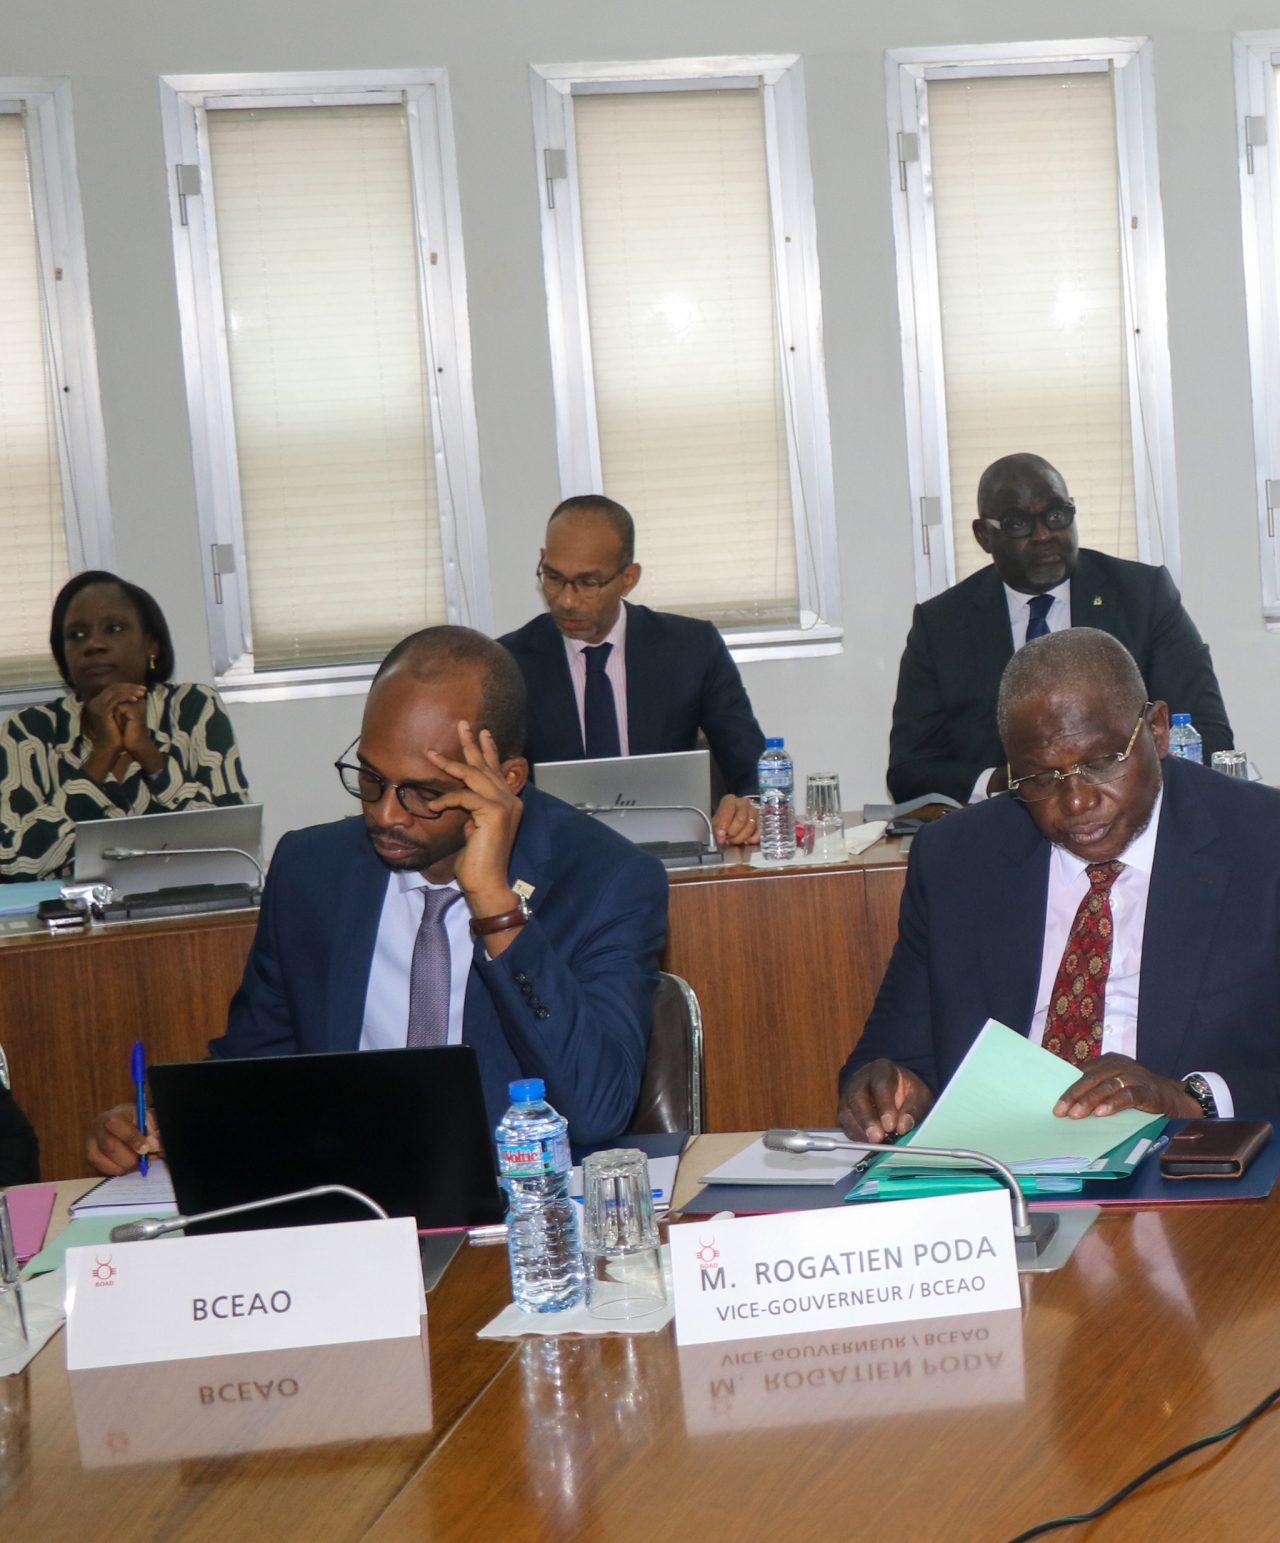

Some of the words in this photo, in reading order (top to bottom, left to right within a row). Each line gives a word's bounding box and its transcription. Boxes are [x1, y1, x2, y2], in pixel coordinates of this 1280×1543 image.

[701, 1267, 736, 1291] M.
[755, 1246, 903, 1285] ROGATIEN
[914, 1236, 997, 1266] PODA
[193, 1290, 292, 1321] BCEAO
[717, 1285, 903, 1321] VICE-GOUVERNEUR
[921, 1275, 986, 1297] BCEAO
